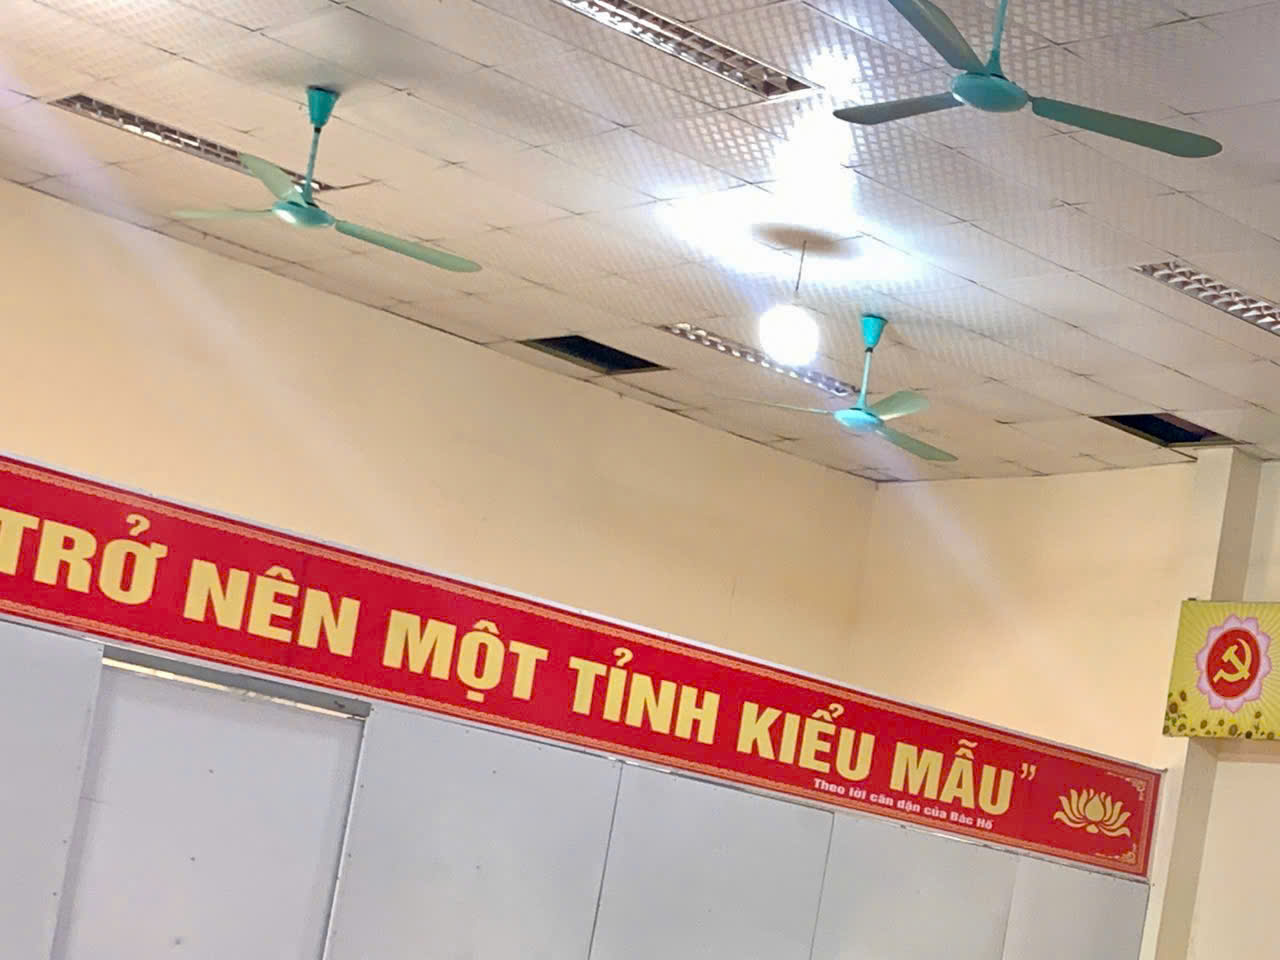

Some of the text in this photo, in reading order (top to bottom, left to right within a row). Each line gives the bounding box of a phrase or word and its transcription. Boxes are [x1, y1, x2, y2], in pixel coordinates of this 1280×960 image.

[0, 507, 168, 605] TRỞ
[183, 559, 361, 657] NÊN
[382, 610, 549, 702] MỘT
[568, 648, 721, 745] TỈNH
[736, 701, 875, 781] KIỂU
[813, 778, 845, 795] Theo
